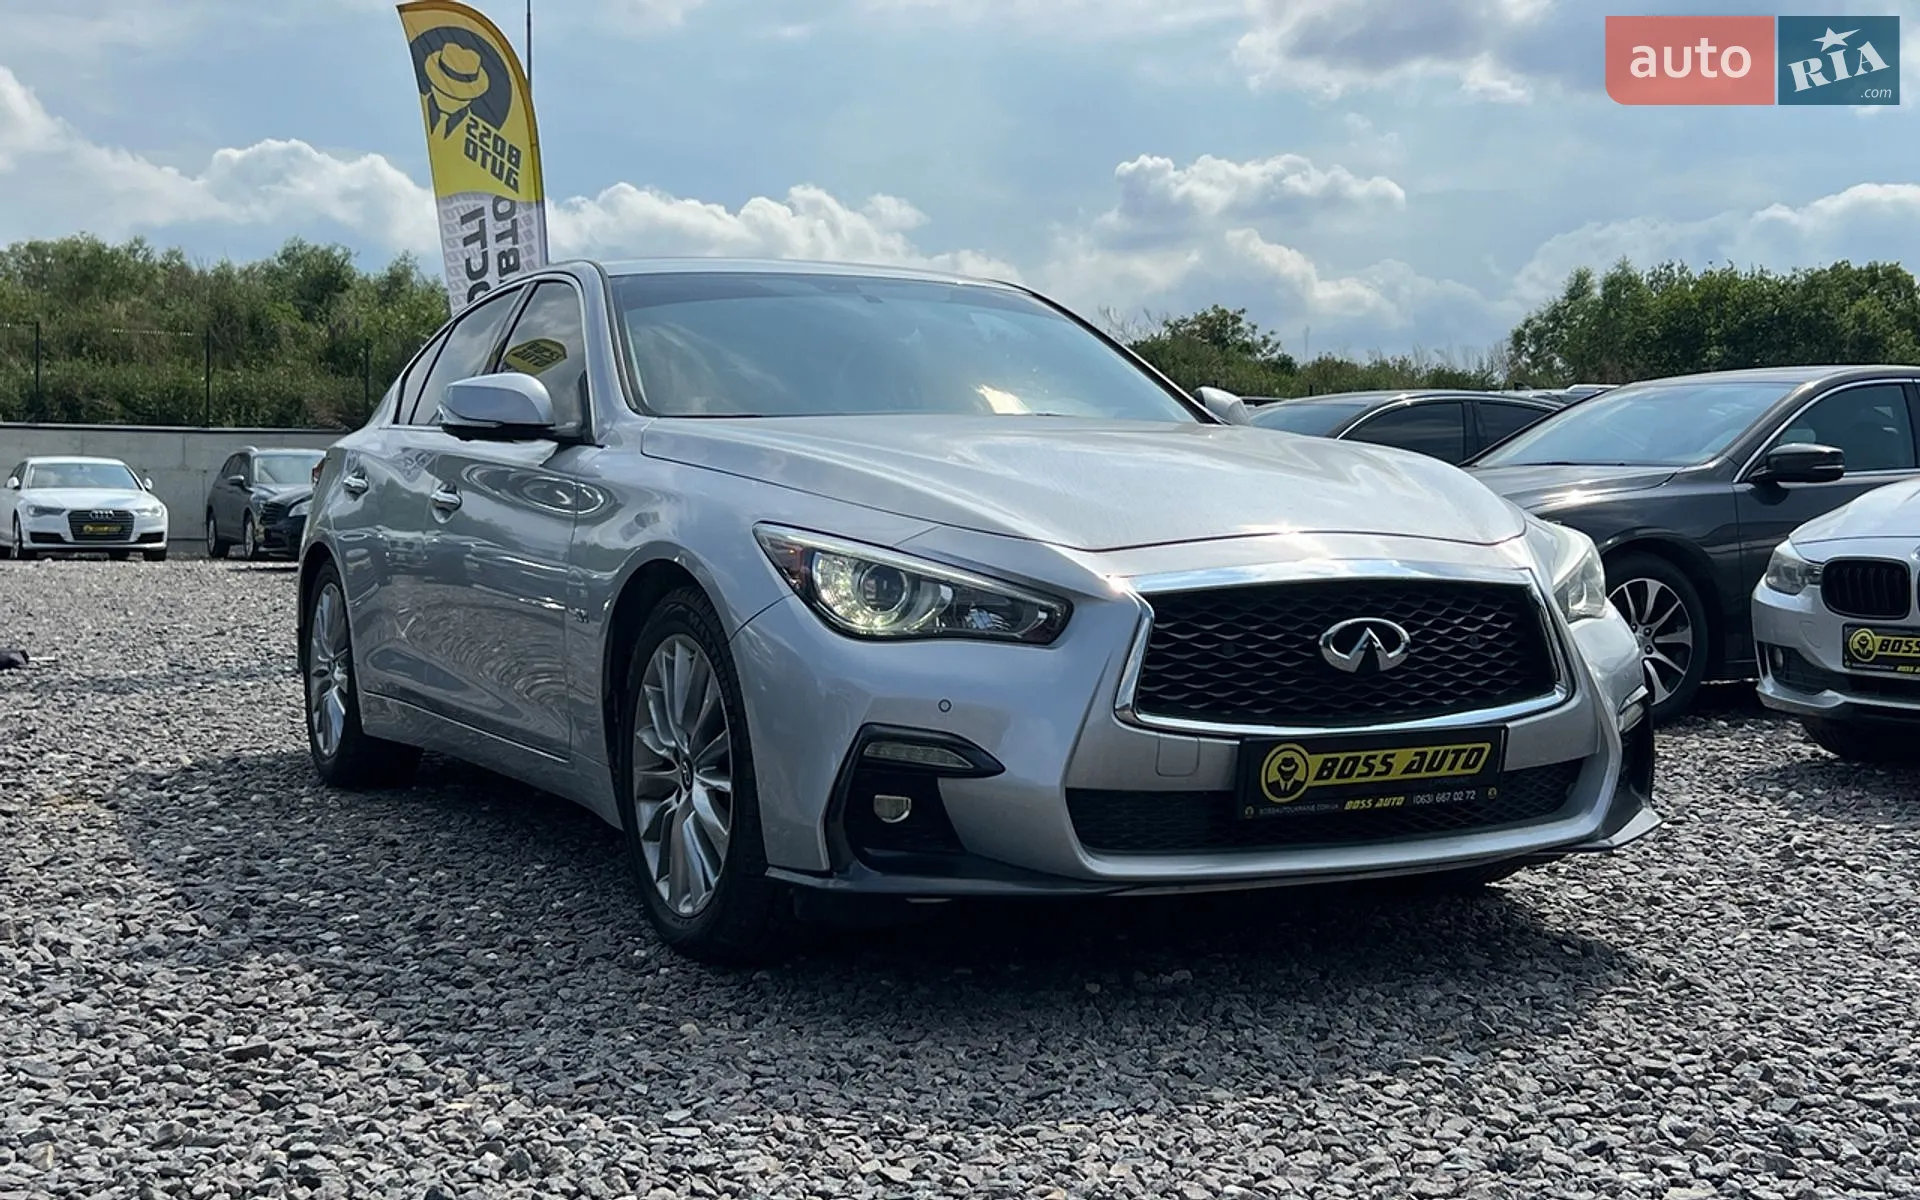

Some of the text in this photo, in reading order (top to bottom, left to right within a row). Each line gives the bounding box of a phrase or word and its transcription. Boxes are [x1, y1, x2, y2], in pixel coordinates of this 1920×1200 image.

[1313, 753, 1397, 782] BOSS
[1401, 747, 1482, 775] AUTO
[1344, 798, 1373, 811] BOSS
[1413, 793, 1434, 805] (063)
[1453, 791, 1464, 801] 02
[1466, 790, 1476, 800] 72
